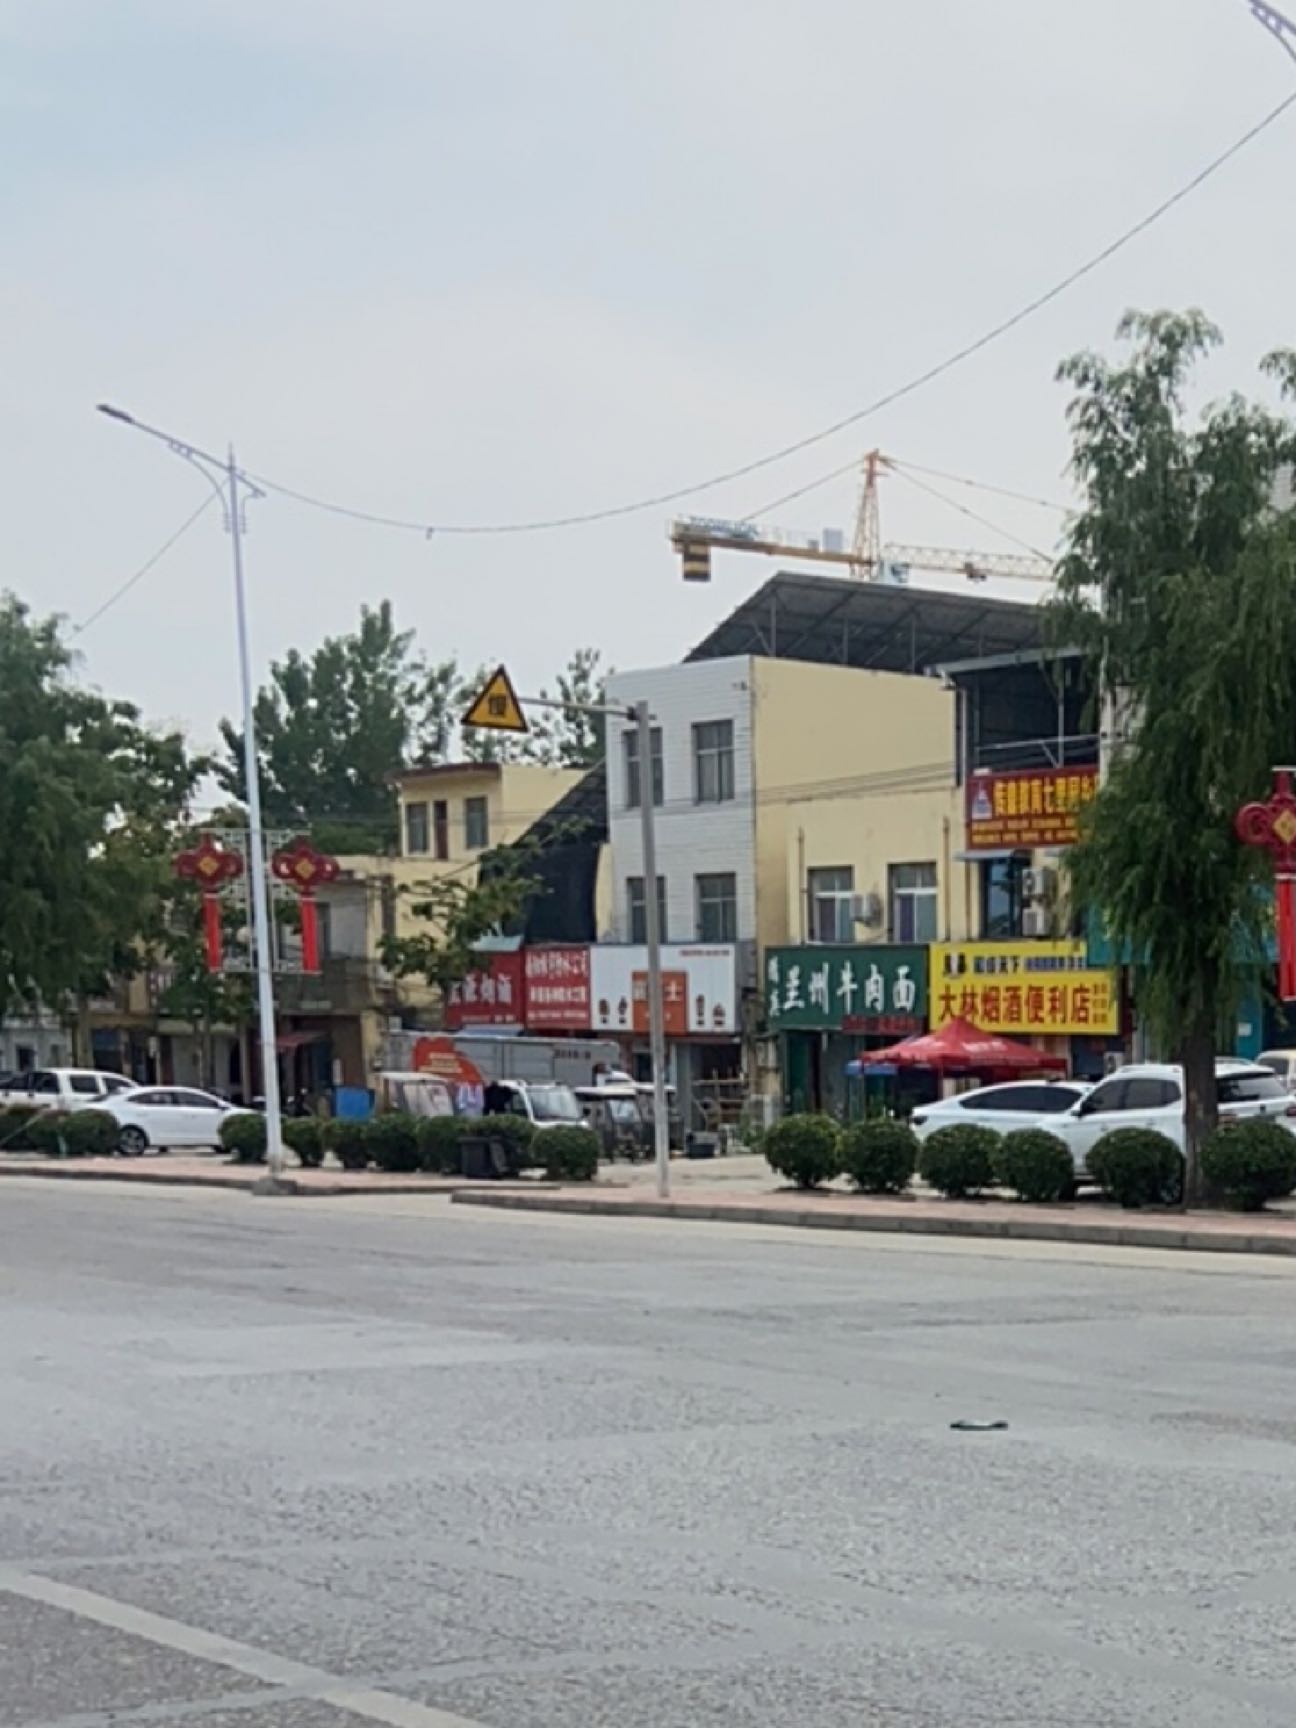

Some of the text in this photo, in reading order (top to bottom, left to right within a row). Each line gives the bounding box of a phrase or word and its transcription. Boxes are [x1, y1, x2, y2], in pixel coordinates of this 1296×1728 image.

[782, 959, 917, 1016] 兰州牛肉面
[938, 983, 1091, 1026] 大林烟酒便利店
